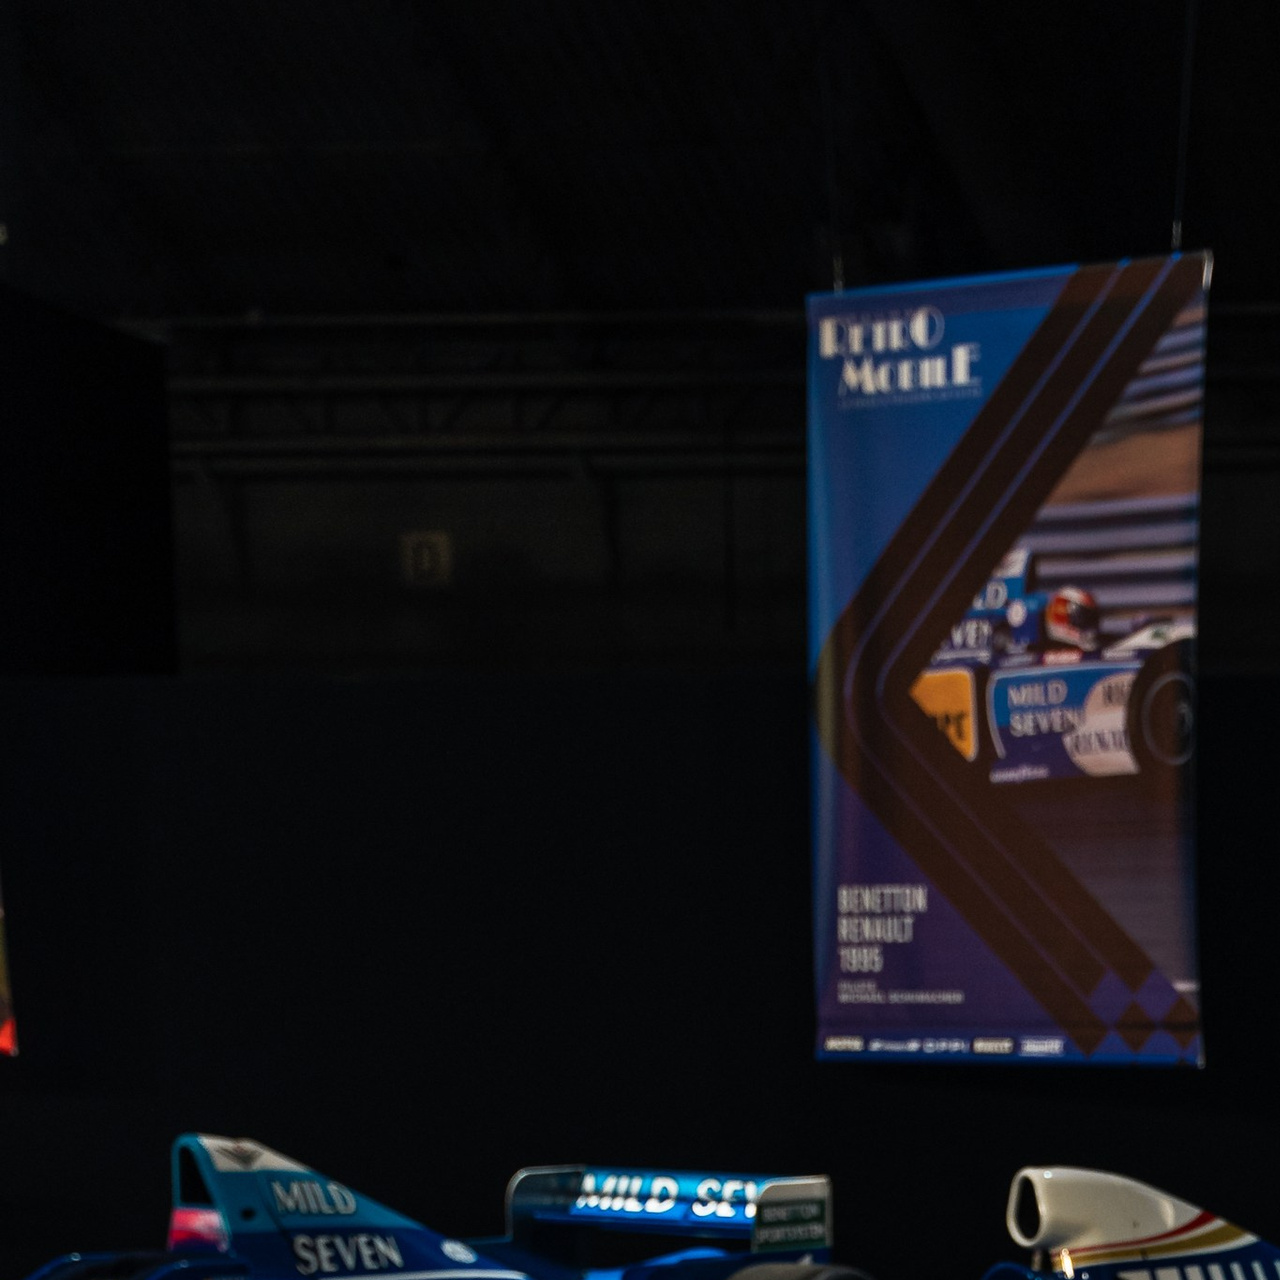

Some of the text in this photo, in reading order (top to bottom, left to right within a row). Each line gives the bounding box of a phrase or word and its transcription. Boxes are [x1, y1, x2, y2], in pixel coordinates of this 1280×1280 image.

[271, 1180, 358, 1215] MILD
[575, 1172, 680, 1214] MILD
[292, 1233, 404, 1276] SEVEN
